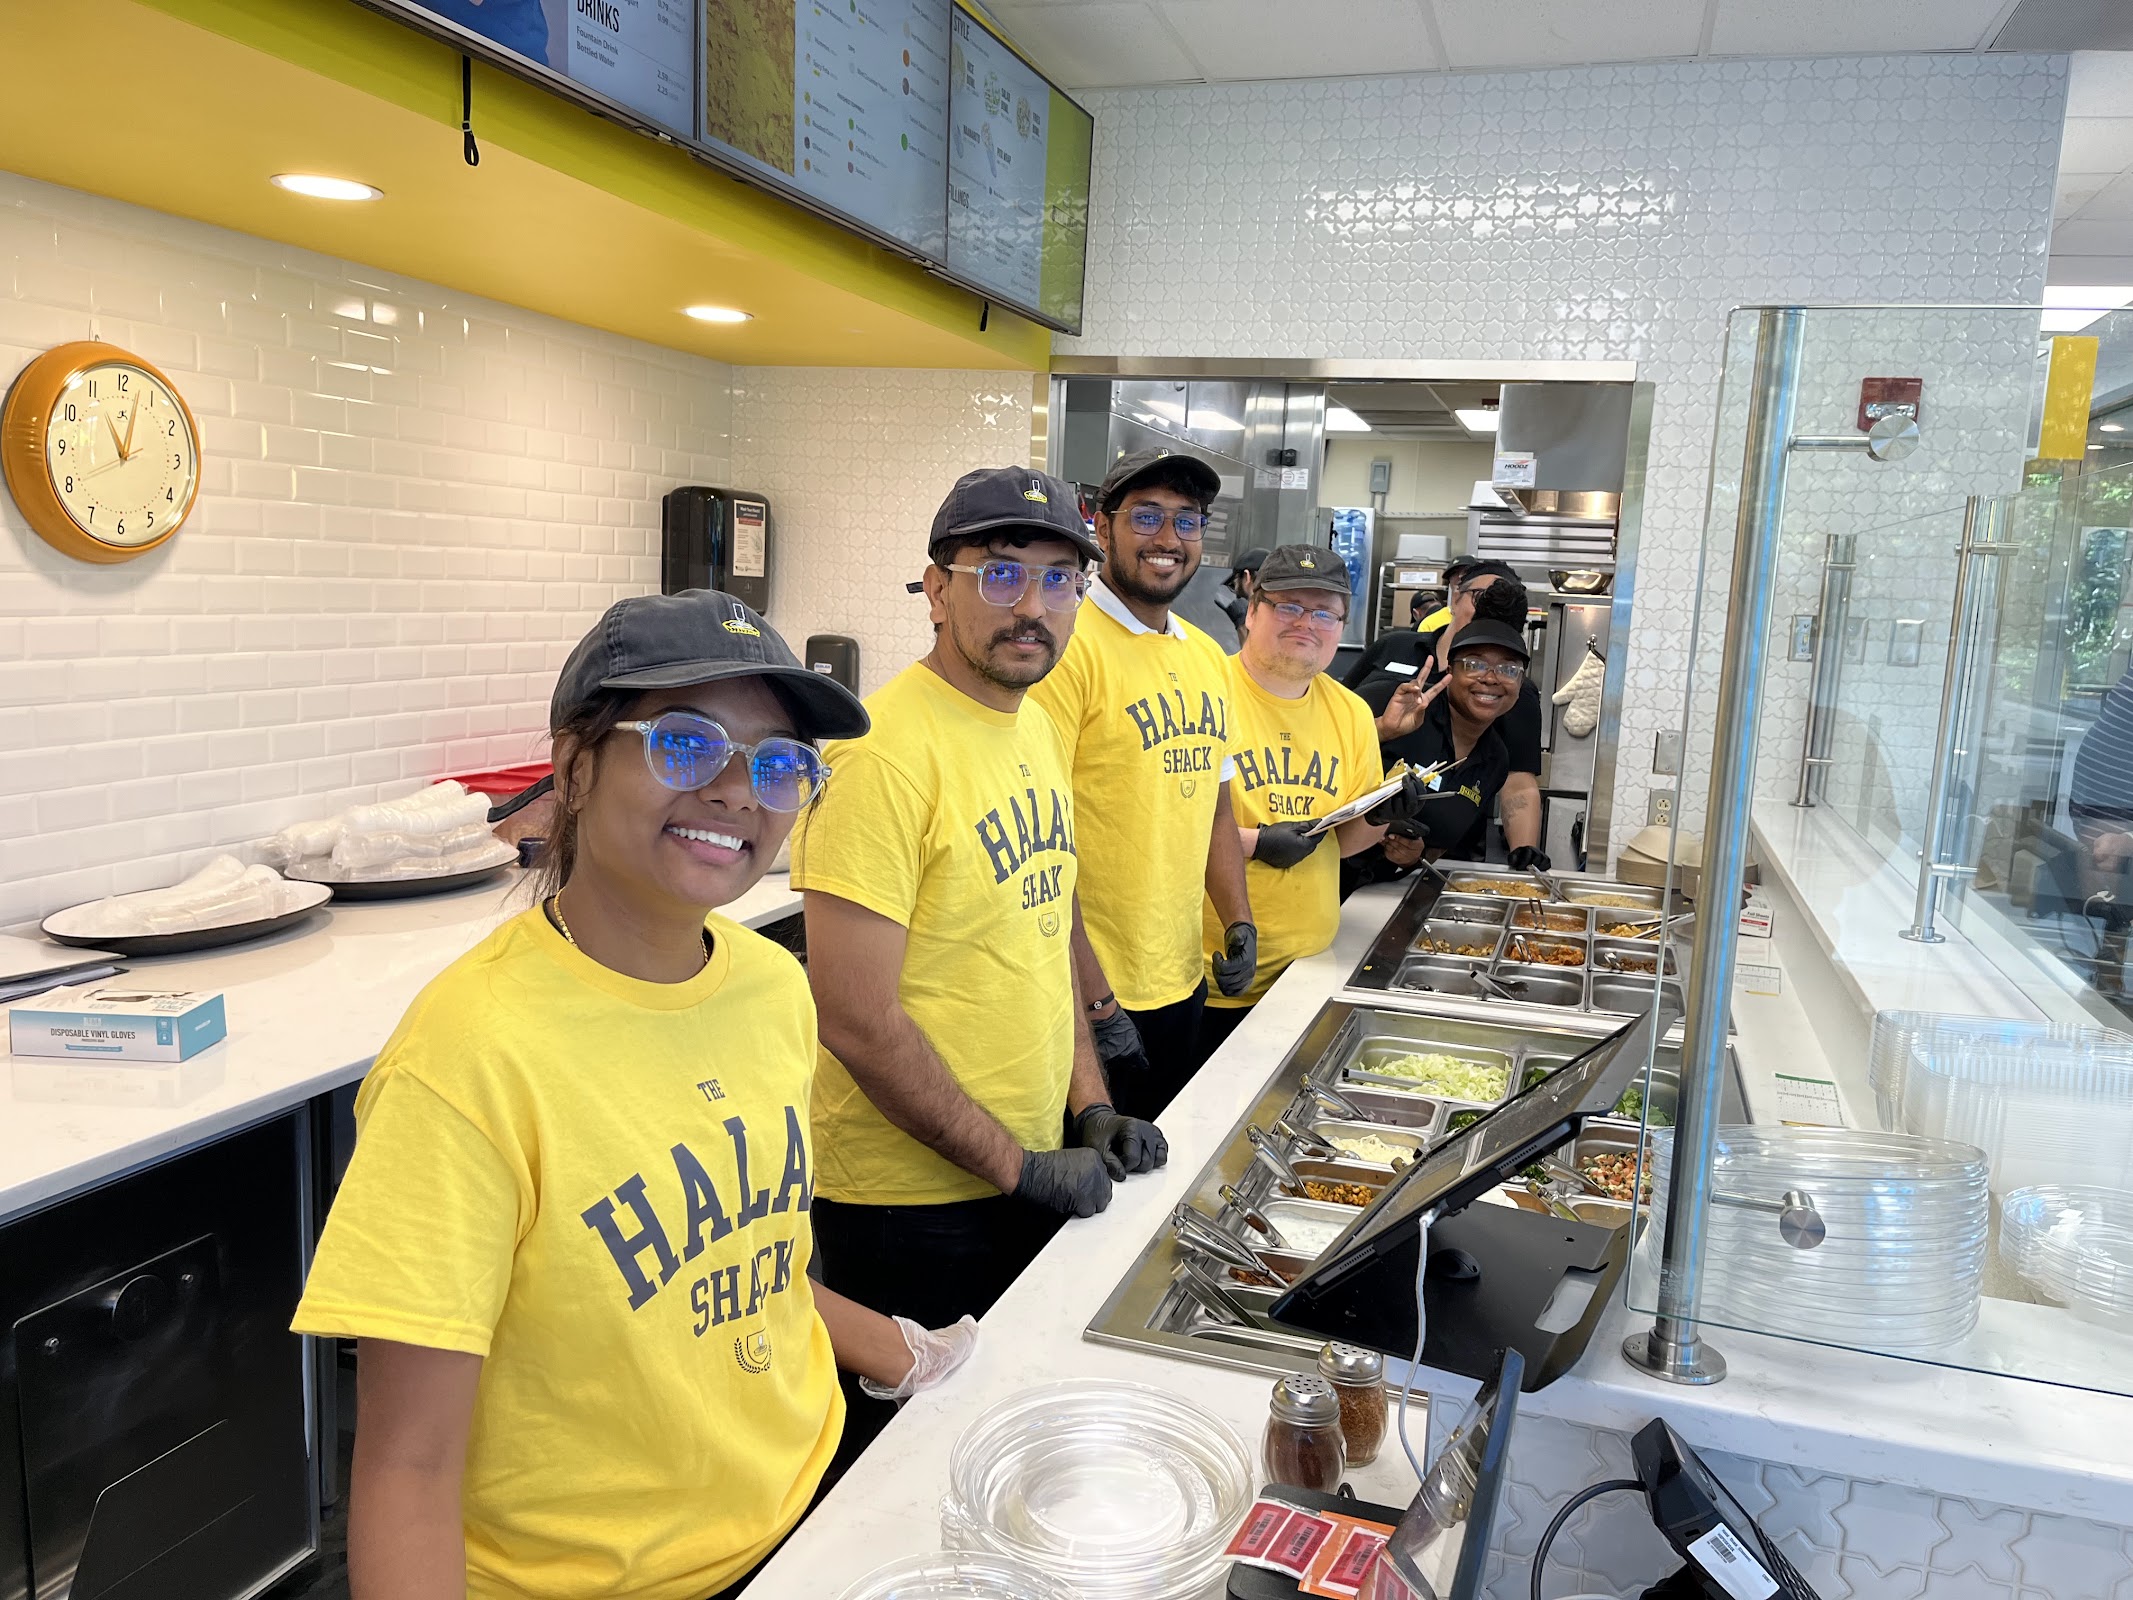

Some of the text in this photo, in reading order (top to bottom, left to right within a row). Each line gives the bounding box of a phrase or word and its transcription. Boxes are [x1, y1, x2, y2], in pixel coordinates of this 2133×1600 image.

[953, 15, 970, 42] STYLE
[576, 26, 619, 56] Fountain Drink
[576, 41, 616, 68] Bottled Water
[89, 380, 97, 398] 11
[118, 374, 129, 392] 12
[150, 390, 154, 407] 1
[64, 403, 76, 422] 10
[168, 420, 175, 437] 2
[58, 439, 66, 456] 9
[173, 454, 181, 470] 3
[65, 476, 73, 493] 8
[166, 487, 174, 503] 4
[87, 506, 95, 524] 7
[147, 511, 154, 528] 5
[117, 519, 125, 535] 6
[1280, 732, 1291, 741] THE
[1163, 746, 1212, 774] SHACK
[1232, 747, 1340, 797] HALAL
[1269, 792, 1315, 816] SHACK
[1022, 864, 1063, 910] SHAK
[50, 1028, 90, 1038] DISPOSABLE
[91, 1030, 110, 1039] VINYL
[111, 1031, 136, 1040] GLOVES
[697, 1078, 726, 1102] THE
[580, 1106, 815, 1312] HALA
[690, 1236, 795, 1338] SHACK
